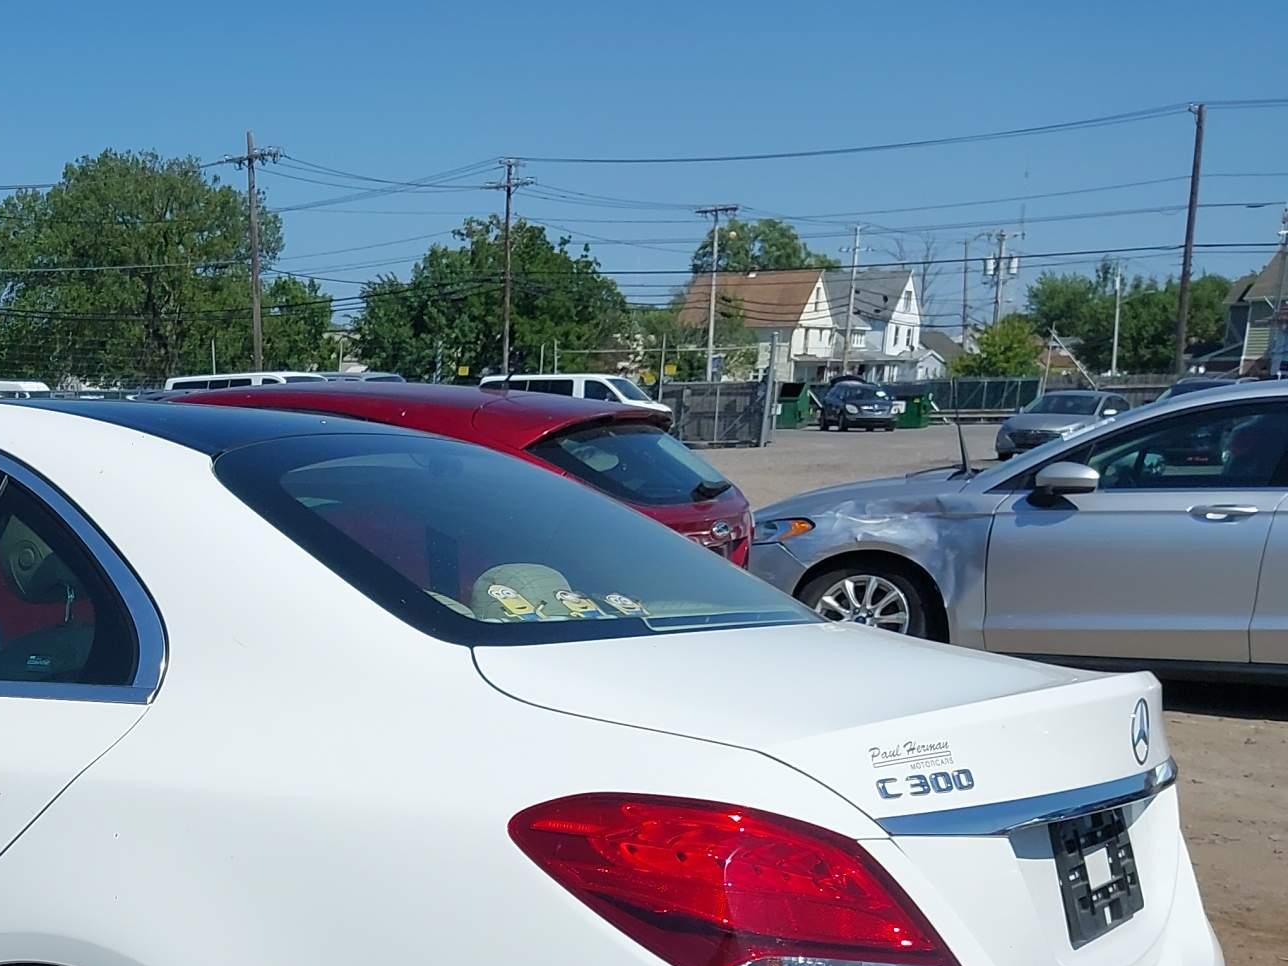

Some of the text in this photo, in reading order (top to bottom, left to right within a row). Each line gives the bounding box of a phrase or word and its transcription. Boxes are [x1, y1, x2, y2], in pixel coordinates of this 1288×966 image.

[868, 740, 950, 763] Paul Herman
[910, 757, 954, 770] MOTORCARS
[875, 768, 976, 800] C 300
